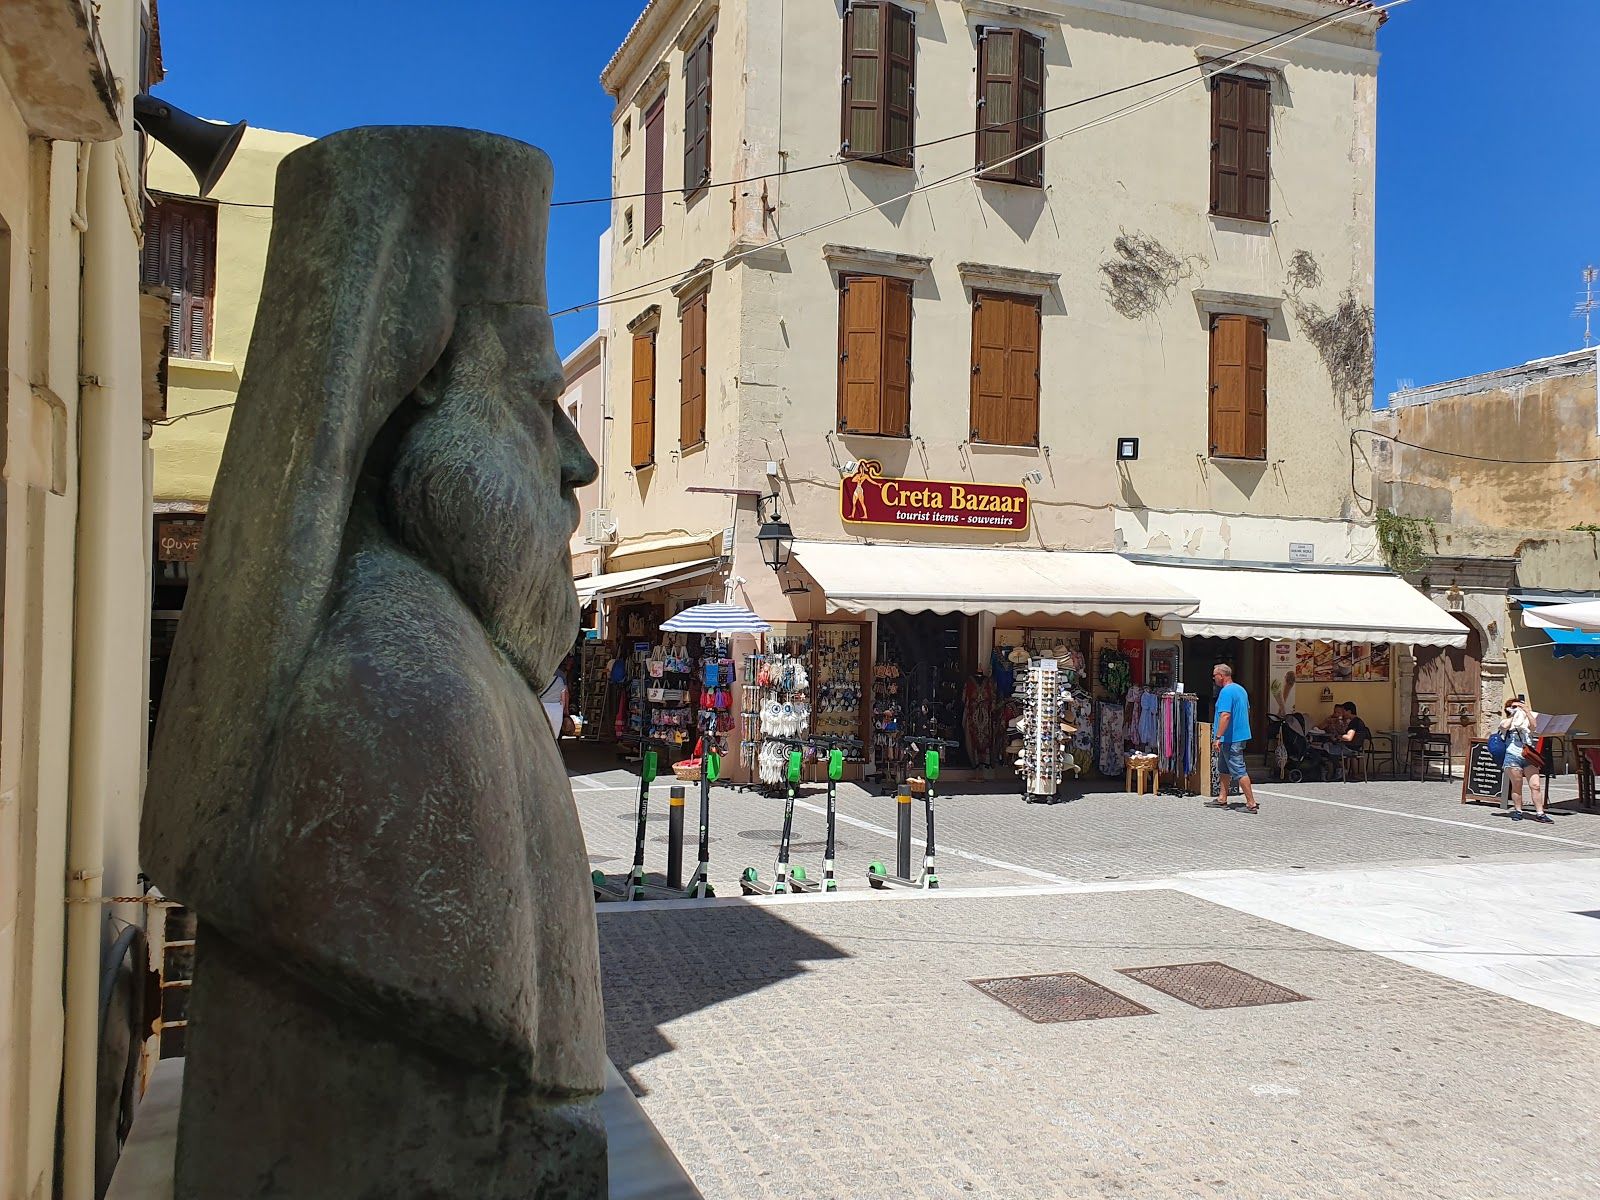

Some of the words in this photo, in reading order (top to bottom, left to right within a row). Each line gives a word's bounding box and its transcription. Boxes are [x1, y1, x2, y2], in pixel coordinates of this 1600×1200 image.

[881, 482, 943, 508] Creta
[949, 486, 1024, 513] Bazaar
[896, 510, 930, 521] tourist
[932, 511, 959, 523] items
[967, 515, 1013, 525] souvenirs
